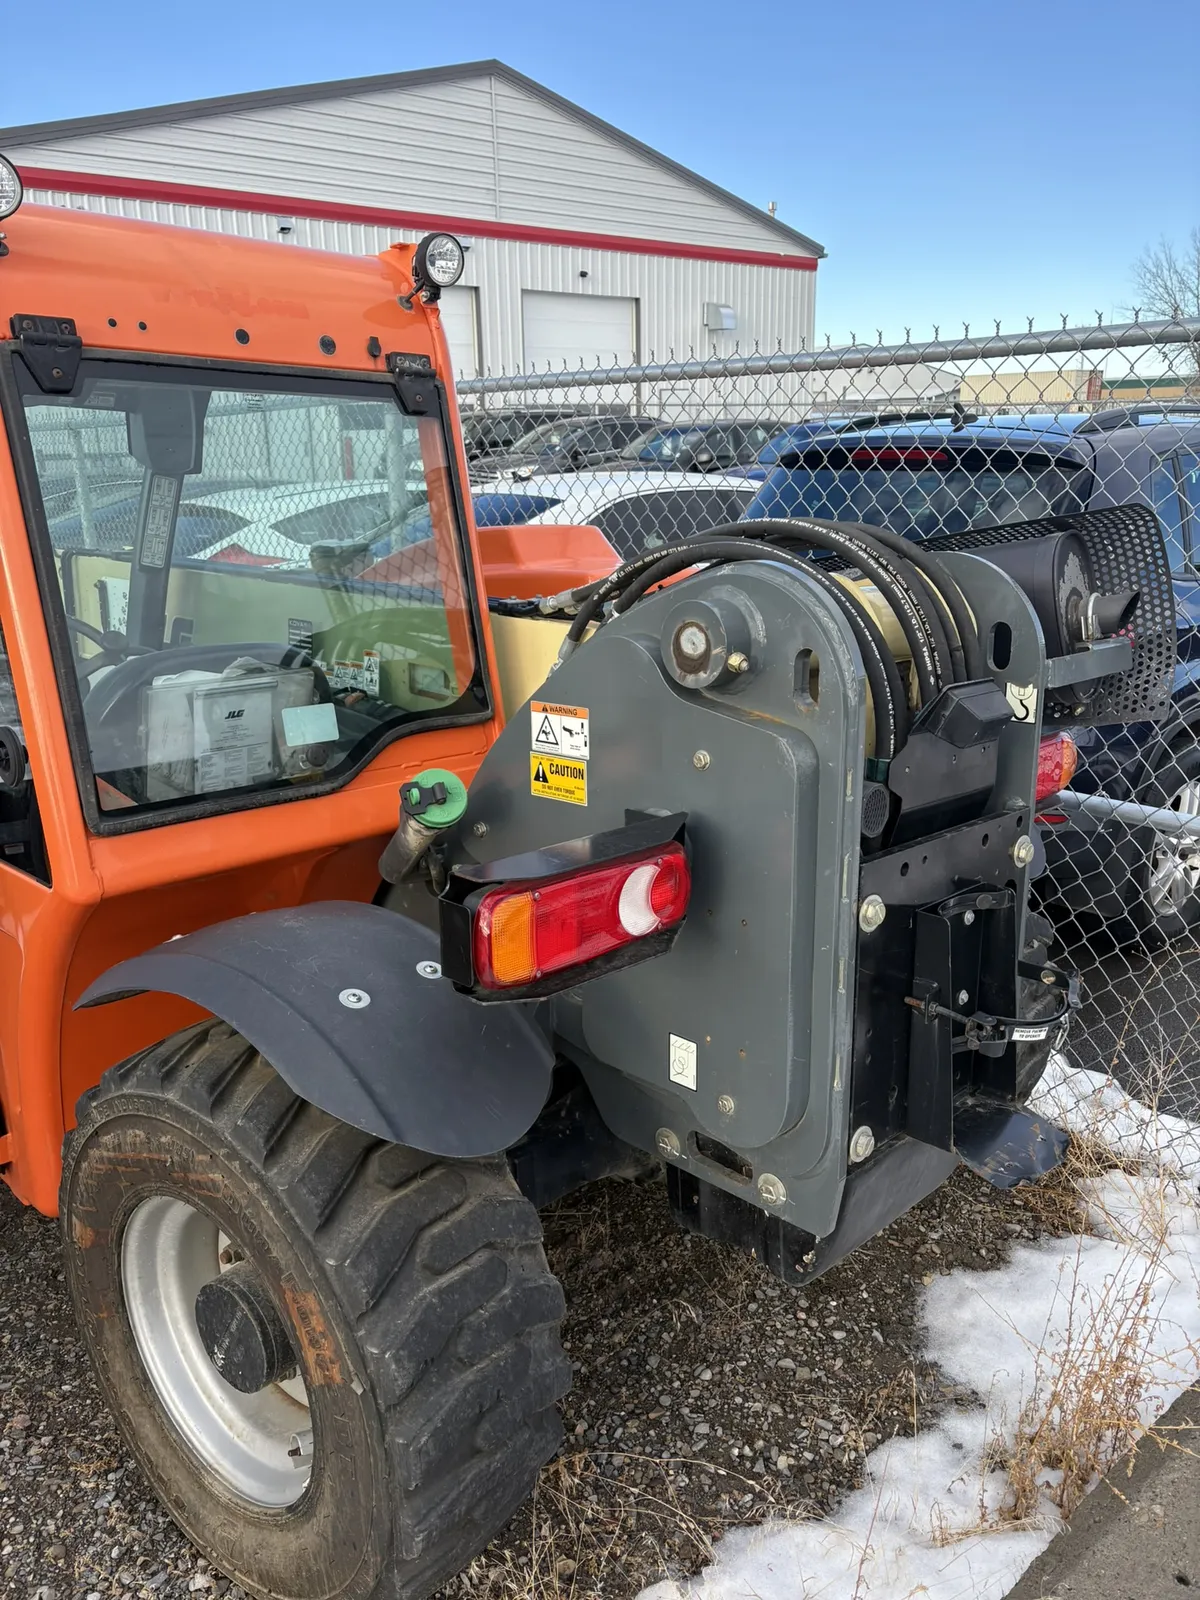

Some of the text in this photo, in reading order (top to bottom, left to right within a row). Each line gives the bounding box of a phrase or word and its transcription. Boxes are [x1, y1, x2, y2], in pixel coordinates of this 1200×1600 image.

[858, 549, 869, 559] WP
[867, 558, 879, 569] PSI
[877, 567, 892, 582] 4000
[887, 564, 897, 575] PSI
[895, 574, 908, 589] 4000
[224, 709, 245, 720] JLG
[549, 705, 578, 716] WARNING
[550, 762, 584, 780] CAUTION
